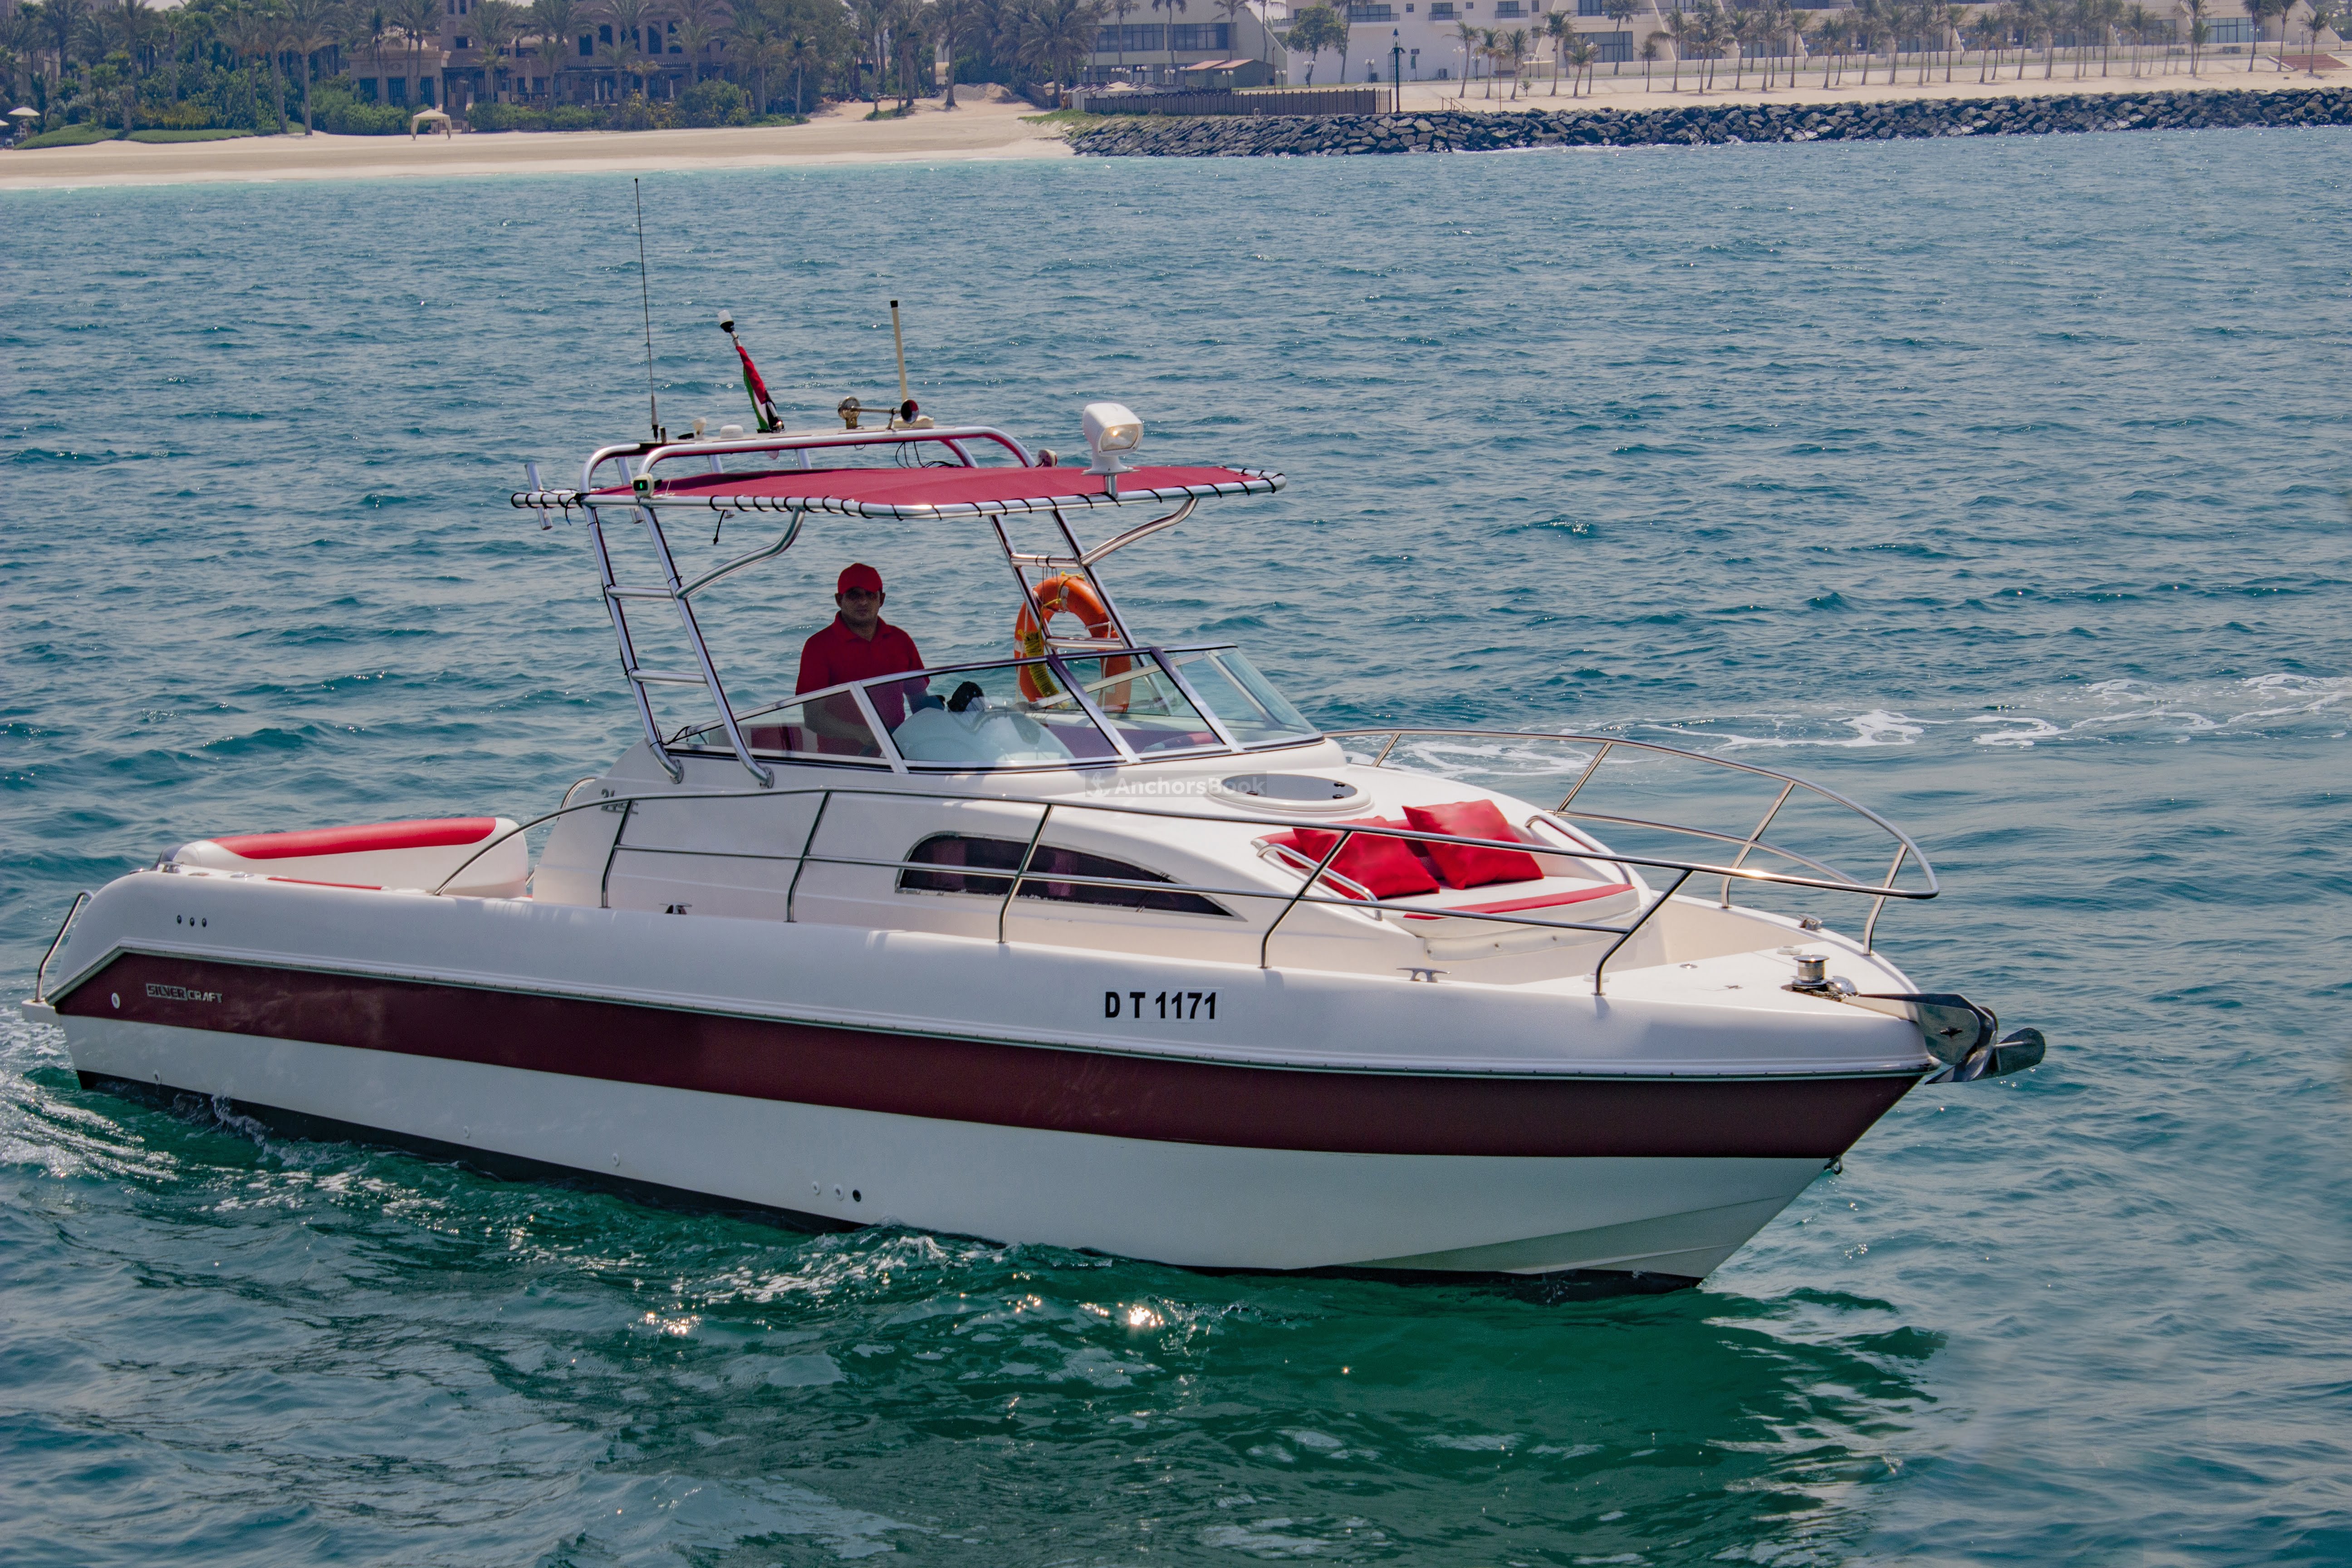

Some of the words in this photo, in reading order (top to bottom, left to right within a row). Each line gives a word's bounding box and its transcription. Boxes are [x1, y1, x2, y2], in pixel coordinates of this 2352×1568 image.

[147, 984, 186, 999] SILVER
[187, 990, 222, 1003] CRAFT
[1155, 991, 1216, 1019] 1171
